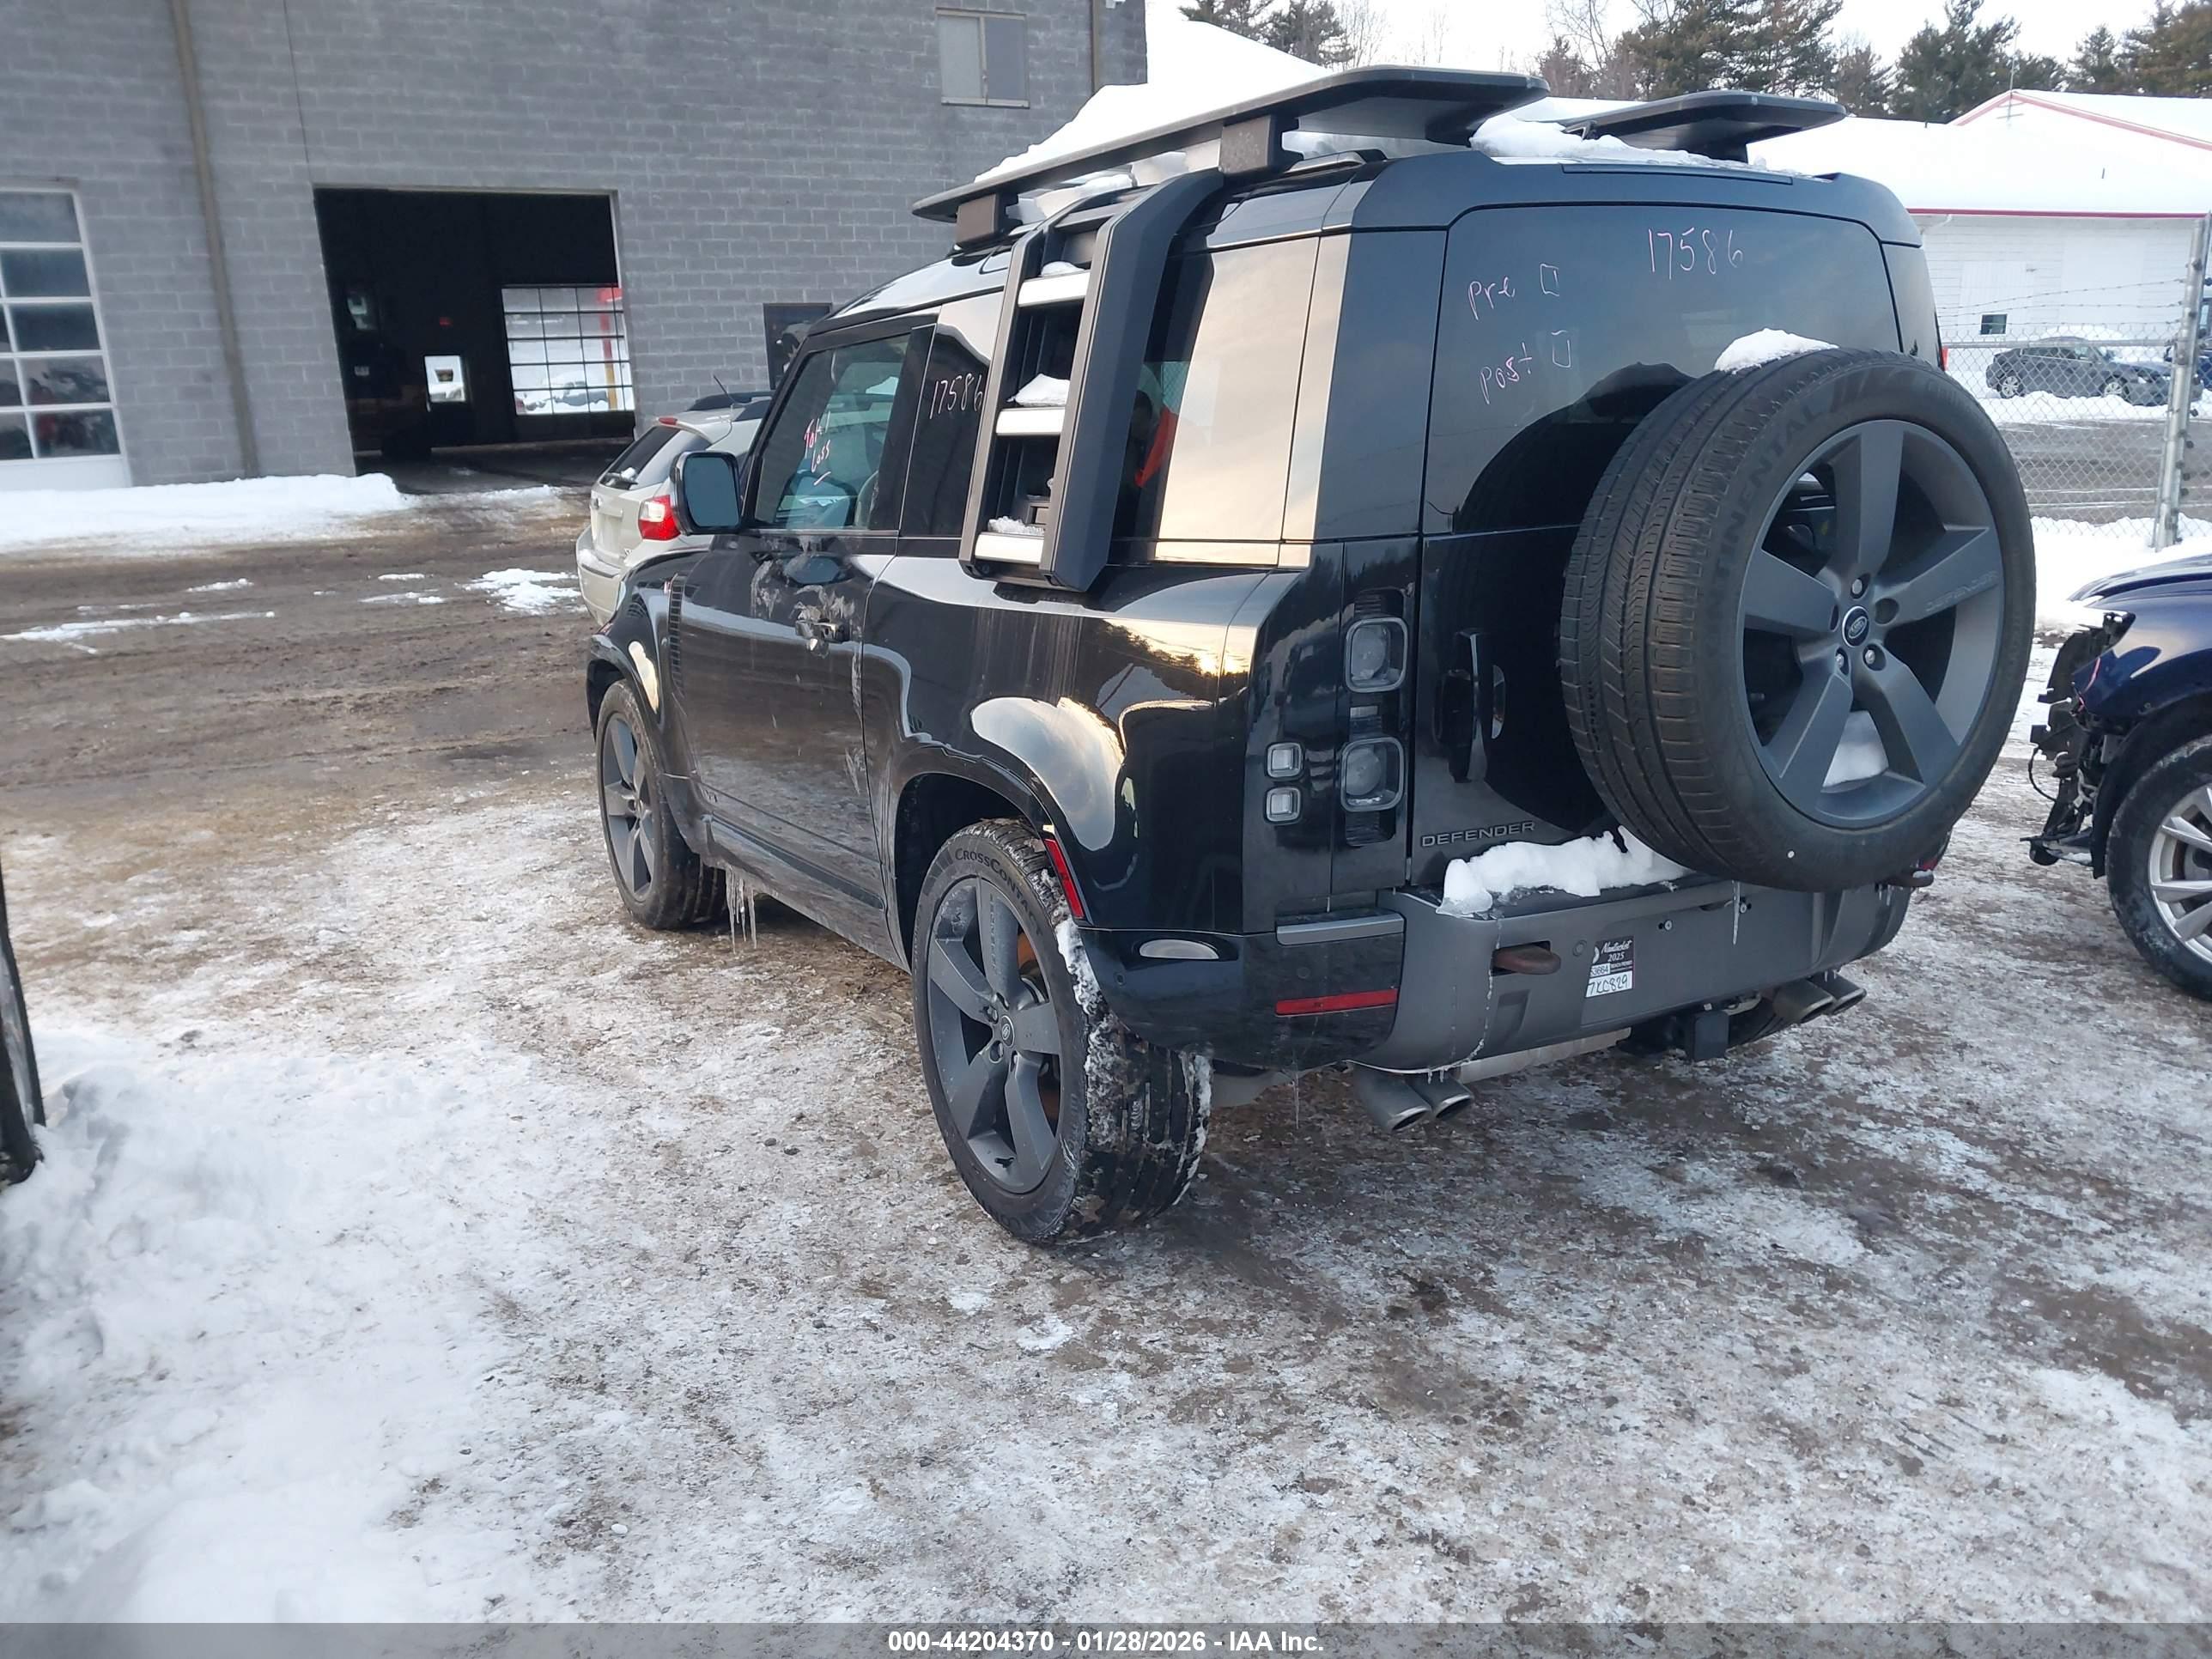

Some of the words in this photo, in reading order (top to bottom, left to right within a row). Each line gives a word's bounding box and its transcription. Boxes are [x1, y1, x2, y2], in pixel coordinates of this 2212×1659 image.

[1647, 227, 1744, 280] 17586
[928, 372, 984, 420] 17586
[1420, 821, 1536, 848] DEFENDER
[1607, 951, 1626, 963] 2025
